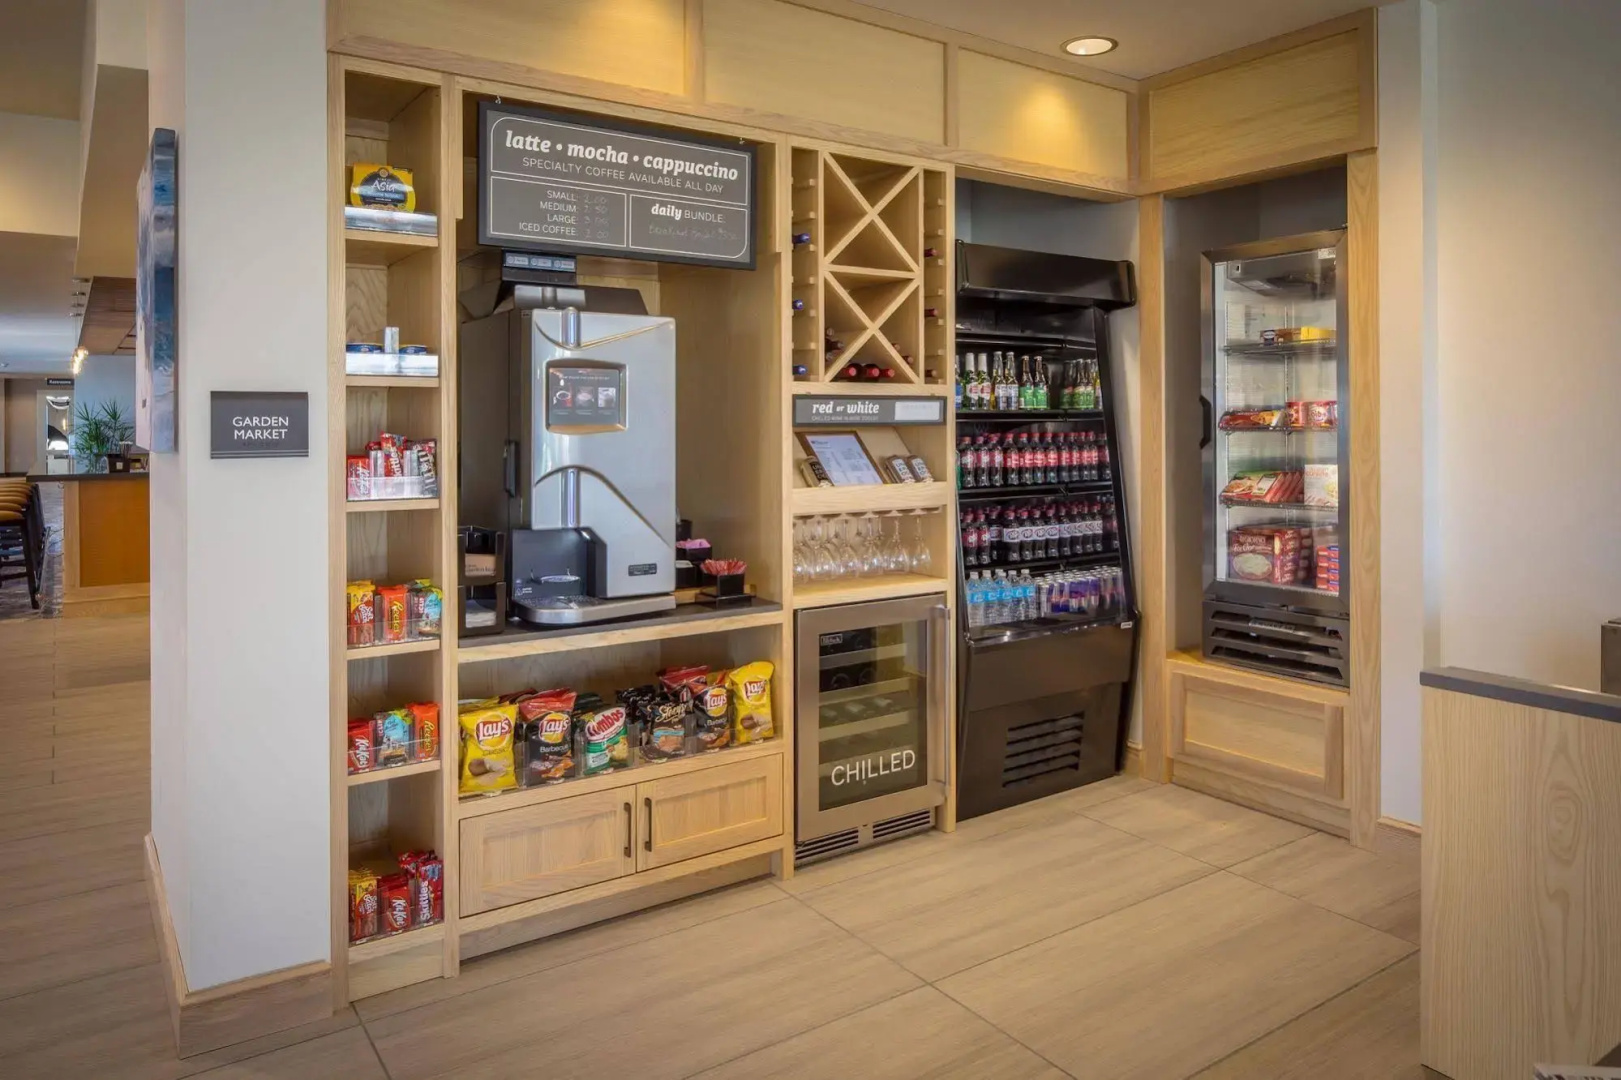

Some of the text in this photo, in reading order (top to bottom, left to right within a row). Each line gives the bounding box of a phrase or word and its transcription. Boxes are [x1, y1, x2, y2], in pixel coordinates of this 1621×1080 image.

[505, 130, 739, 181] latte mocha cappuccino
[522, 157, 724, 194] SPECIALTY COFFEE AVAILABLE ALL DAY
[651, 203, 682, 221] daily
[519, 222, 540, 232] ICED
[812, 401, 834, 414] red
[847, 401, 880, 414] white
[232, 416, 289, 427] GARDEN
[234, 429, 288, 440] MARKET
[831, 749, 916, 786] CHILLED
